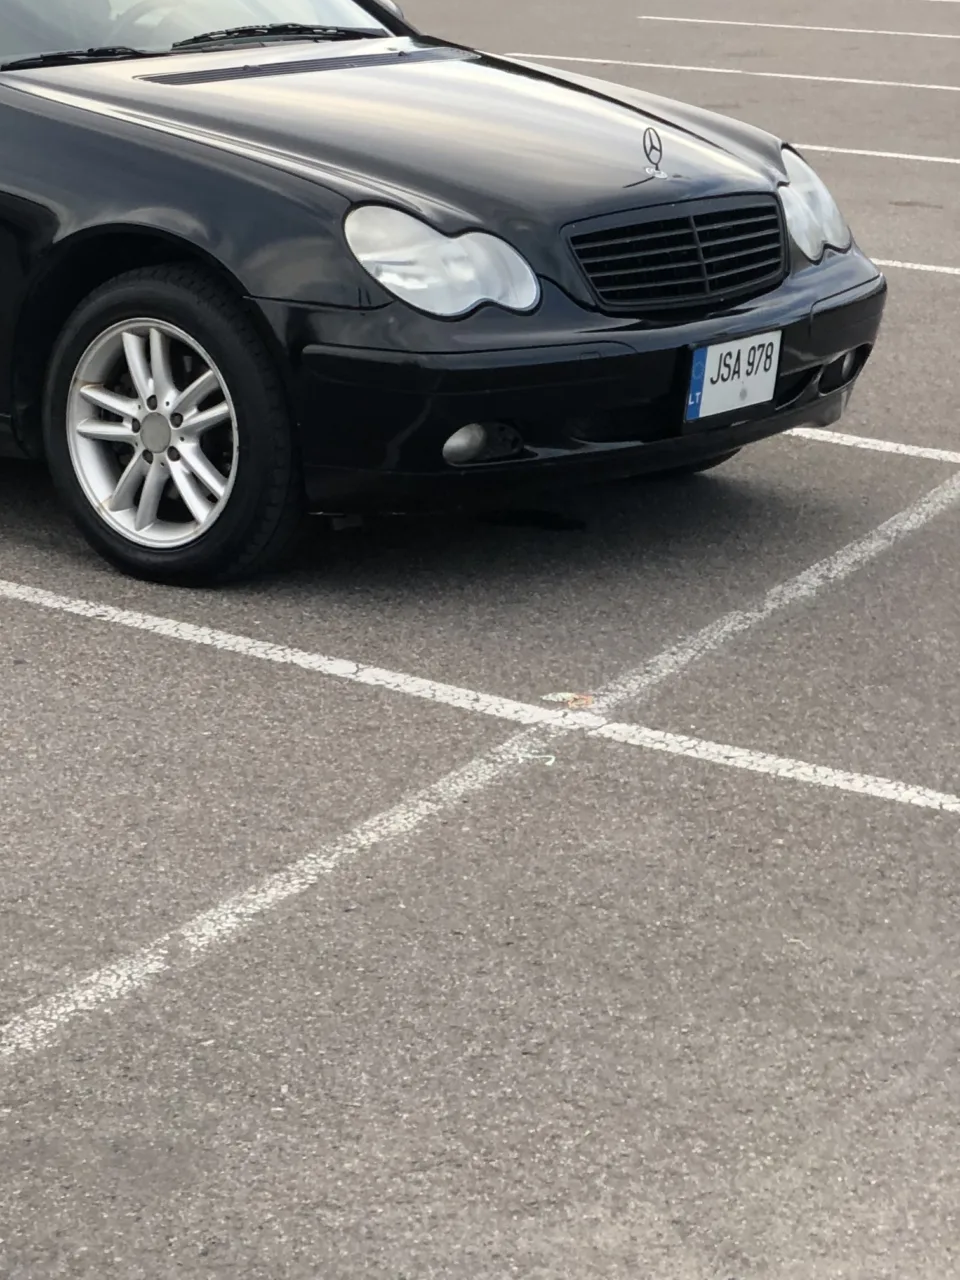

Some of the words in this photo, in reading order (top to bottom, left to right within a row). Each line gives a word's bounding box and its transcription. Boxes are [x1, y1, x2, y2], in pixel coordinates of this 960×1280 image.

[710, 349, 741, 385] JSA
[746, 341, 774, 377] 978
[688, 391, 702, 405] LT
